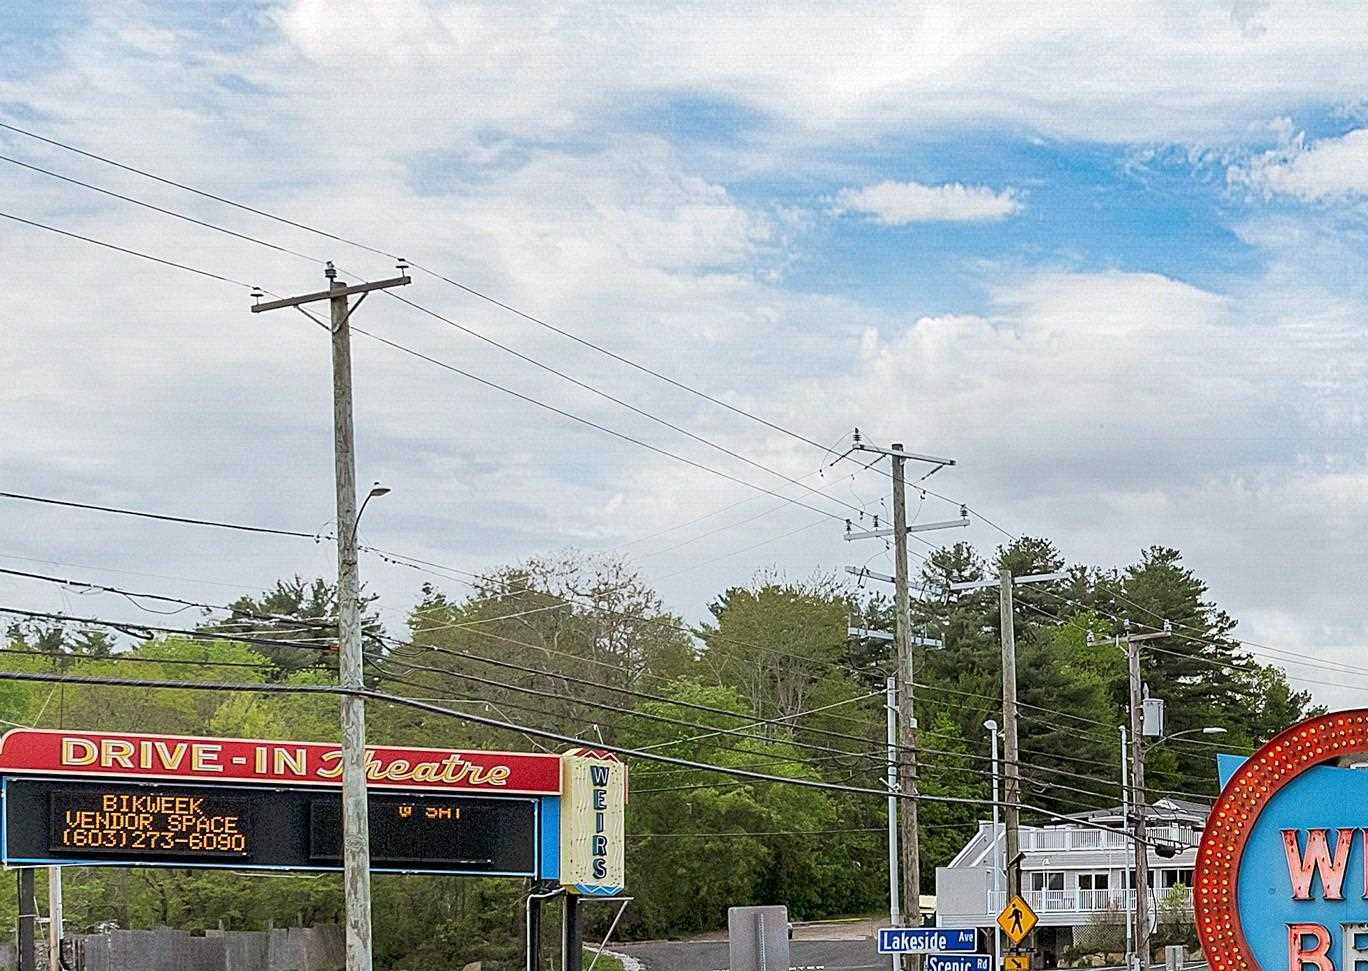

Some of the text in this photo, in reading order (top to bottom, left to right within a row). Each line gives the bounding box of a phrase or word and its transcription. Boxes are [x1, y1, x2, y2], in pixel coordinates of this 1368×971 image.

[103, 794, 204, 815] BIKWEEK
[65, 811, 239, 834] VENDOR SPACE
[590, 765, 610, 879] WEIRS
[63, 829, 246, 852] (603)273-6090
[883, 931, 974, 950] Lakeside Ave
[977, 958, 988, 970] Rd
